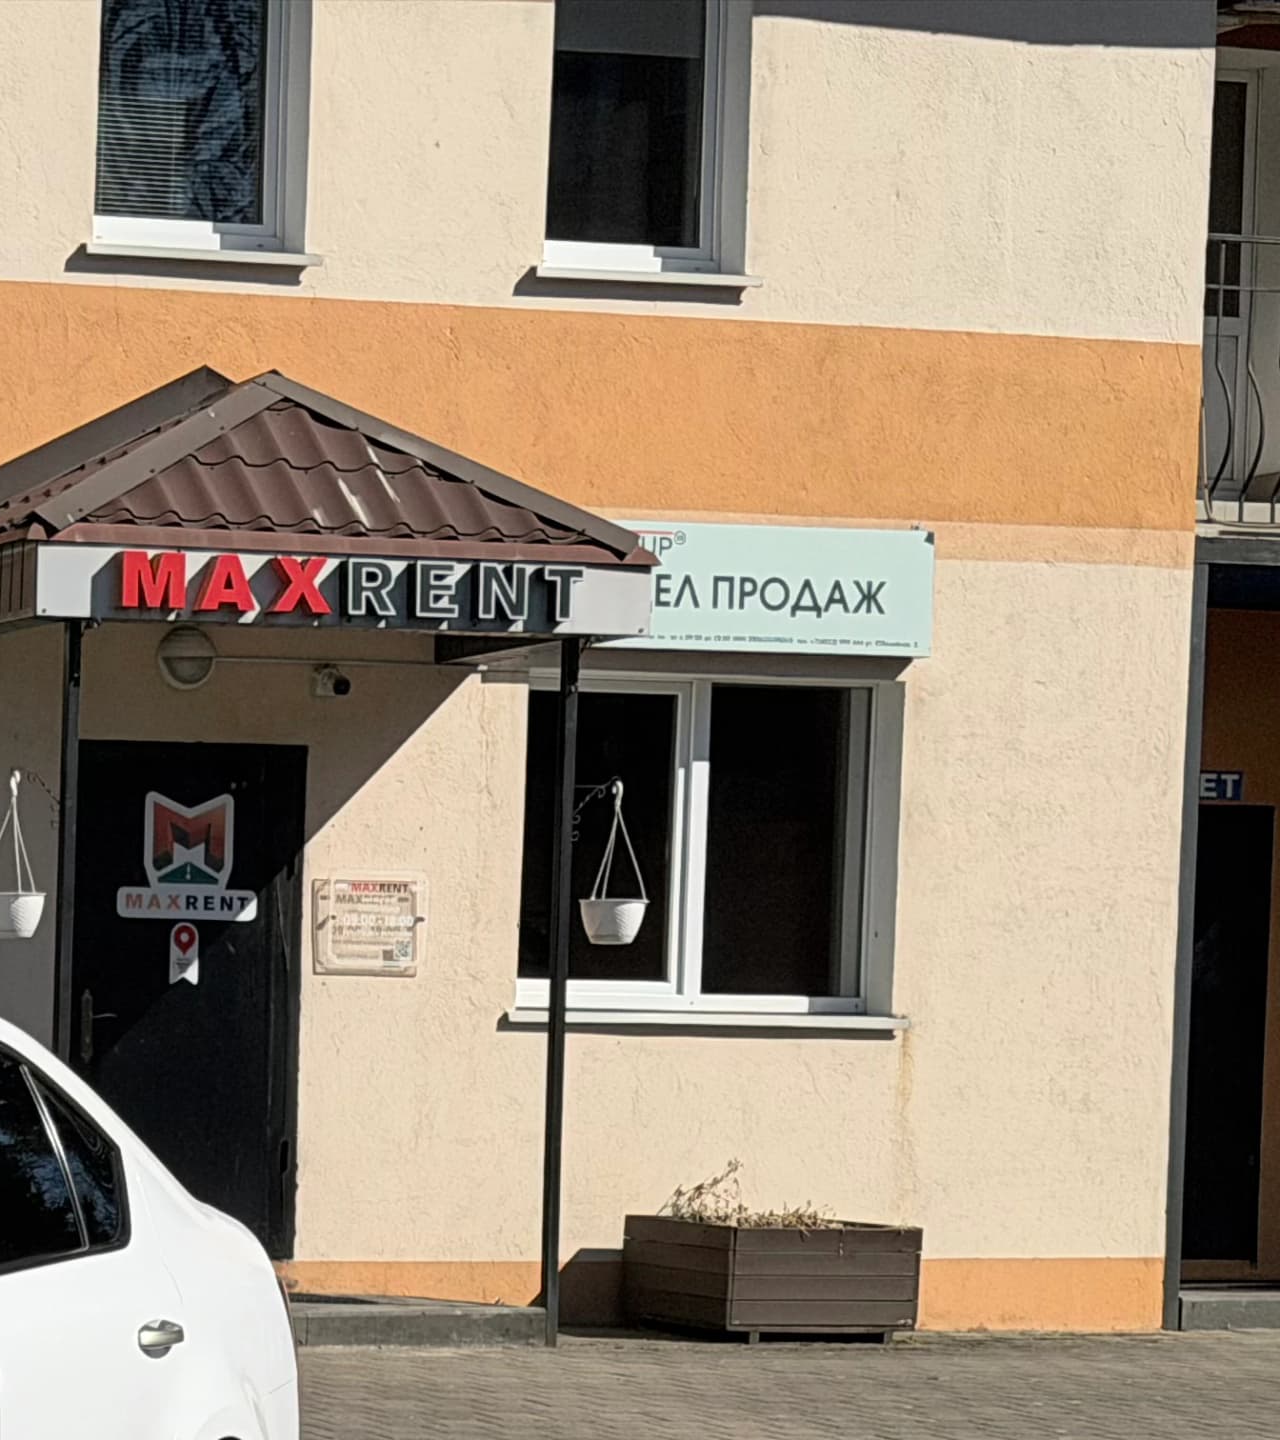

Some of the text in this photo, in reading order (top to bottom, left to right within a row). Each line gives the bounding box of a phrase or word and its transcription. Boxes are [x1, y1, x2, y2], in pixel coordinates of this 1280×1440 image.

[120, 549, 585, 622] MAXRENT
[650, 573, 887, 618] ЕЛ ПРОДАЖ
[1200, 773, 1241, 798] ЕТ
[351, 883, 409, 894] MAXRENT
[125, 893, 249, 912] MAXRENT
